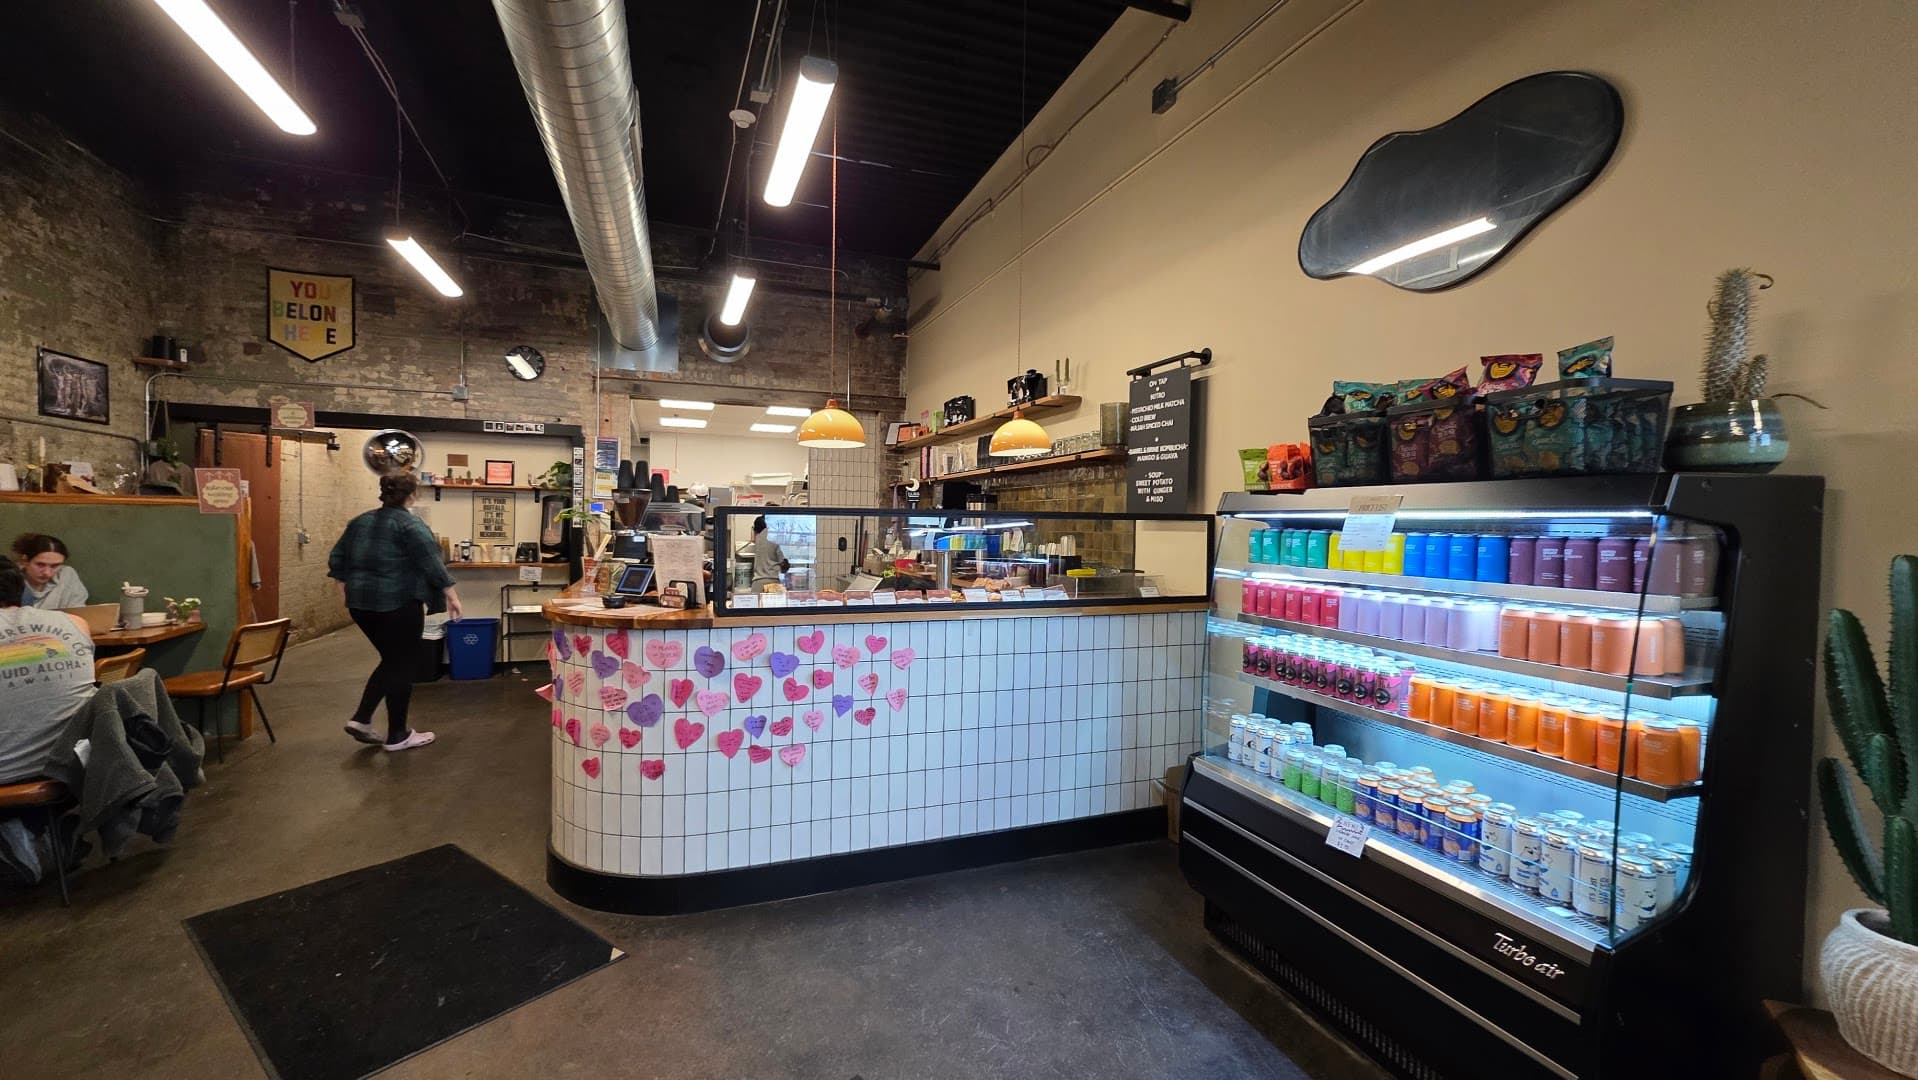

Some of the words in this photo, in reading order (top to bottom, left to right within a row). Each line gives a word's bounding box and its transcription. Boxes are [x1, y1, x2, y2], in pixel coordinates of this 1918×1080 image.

[272, 300, 350, 323] BELONG
[1152, 478, 1173, 486] POTATO
[0, 666, 30, 679] UID
[37, 660, 81, 673] ALOHA
[1493, 932, 1536, 966] Turbo
[1534, 963, 1565, 979] air
